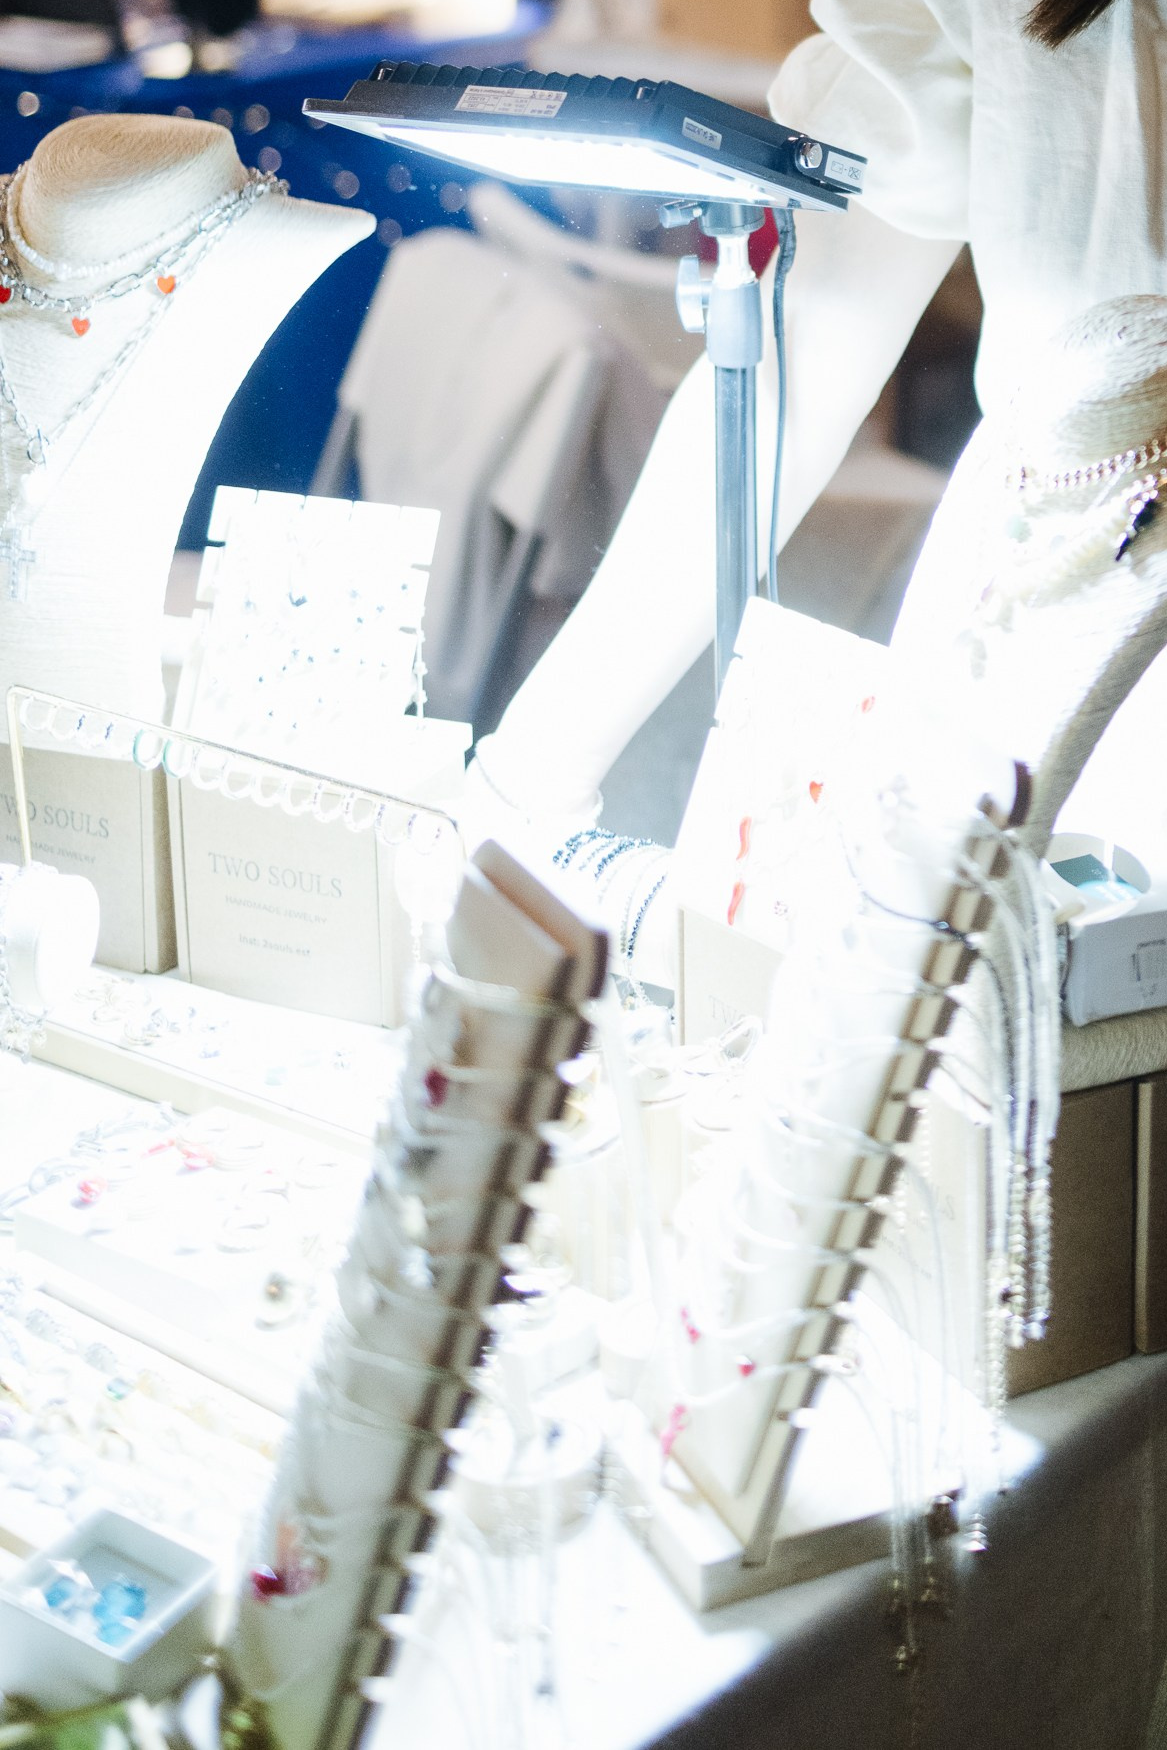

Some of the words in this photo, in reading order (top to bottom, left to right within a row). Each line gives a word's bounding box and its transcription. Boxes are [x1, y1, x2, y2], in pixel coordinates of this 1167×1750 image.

[0, 793, 37, 821] WO
[43, 804, 110, 839] SOULS
[208, 850, 261, 882] TWO
[268, 865, 343, 899] SOULS
[225, 894, 281, 916] HANDMADE
[283, 908, 328, 926] JEWELRY
[708, 994, 747, 1027] TW
